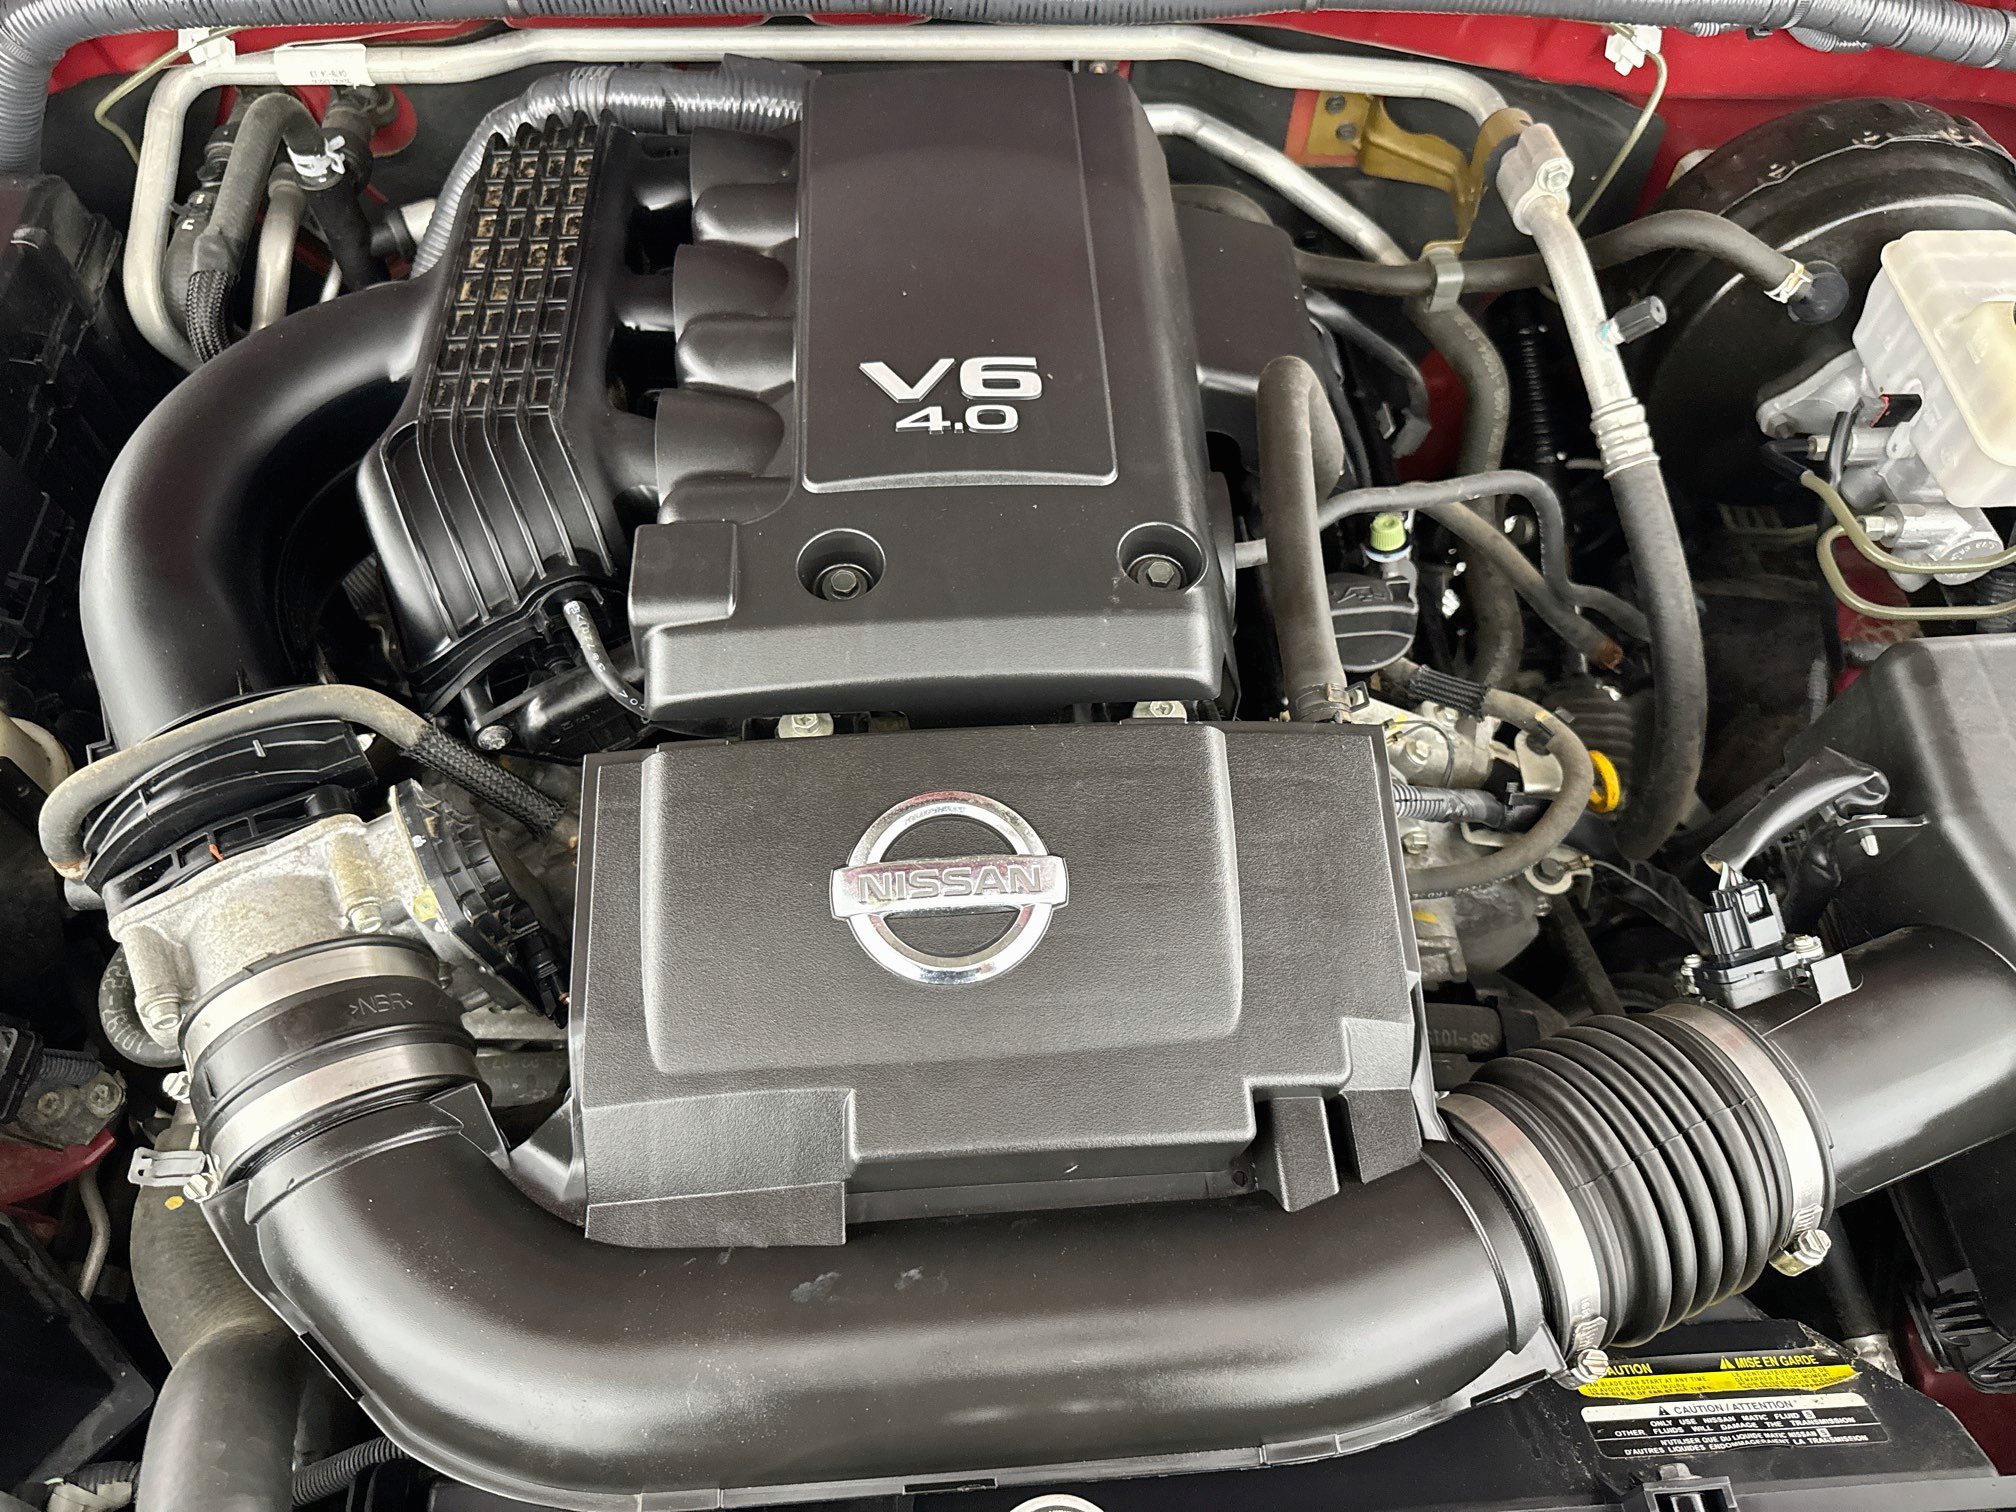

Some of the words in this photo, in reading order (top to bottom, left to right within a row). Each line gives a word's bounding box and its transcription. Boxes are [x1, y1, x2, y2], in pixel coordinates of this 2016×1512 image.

[858, 356, 1043, 404] V6
[895, 404, 1019, 435] 4.0
[857, 864, 1043, 904] NISSAN
[1607, 1363, 1653, 1376] AUTION
[1734, 1356, 1763, 1369] MISE
[1762, 1356, 1780, 1368] EN
[1779, 1354, 1819, 1366] GARDE
[1673, 1404, 1724, 1415] CAUTION
[1732, 1400, 1794, 1411] ATTENTION
[1614, 1429, 1646, 1437] OTHER
[1652, 1427, 1684, 1435] FLUIDS
[1720, 1422, 1759, 1431] DAMAGE
[1789, 1416, 1856, 1427] TRANSMISSION
[1702, 1415, 1736, 1424] NISSAN
[1774, 1412, 1800, 1420] FLUID
[1624, 1446, 1666, 1456] D'AUTRES
[1667, 1444, 1706, 1453] LIQUIDES
[1807, 1434, 1869, 1444] TRANSMISSION
[1660, 1437, 1702, 1446] N'UTILISER
[1701, 1436, 1720, 1444] QUE
[1732, 1432, 1764, 1441] LIQUIDE
[1787, 1430, 1818, 1438] NISSAN
